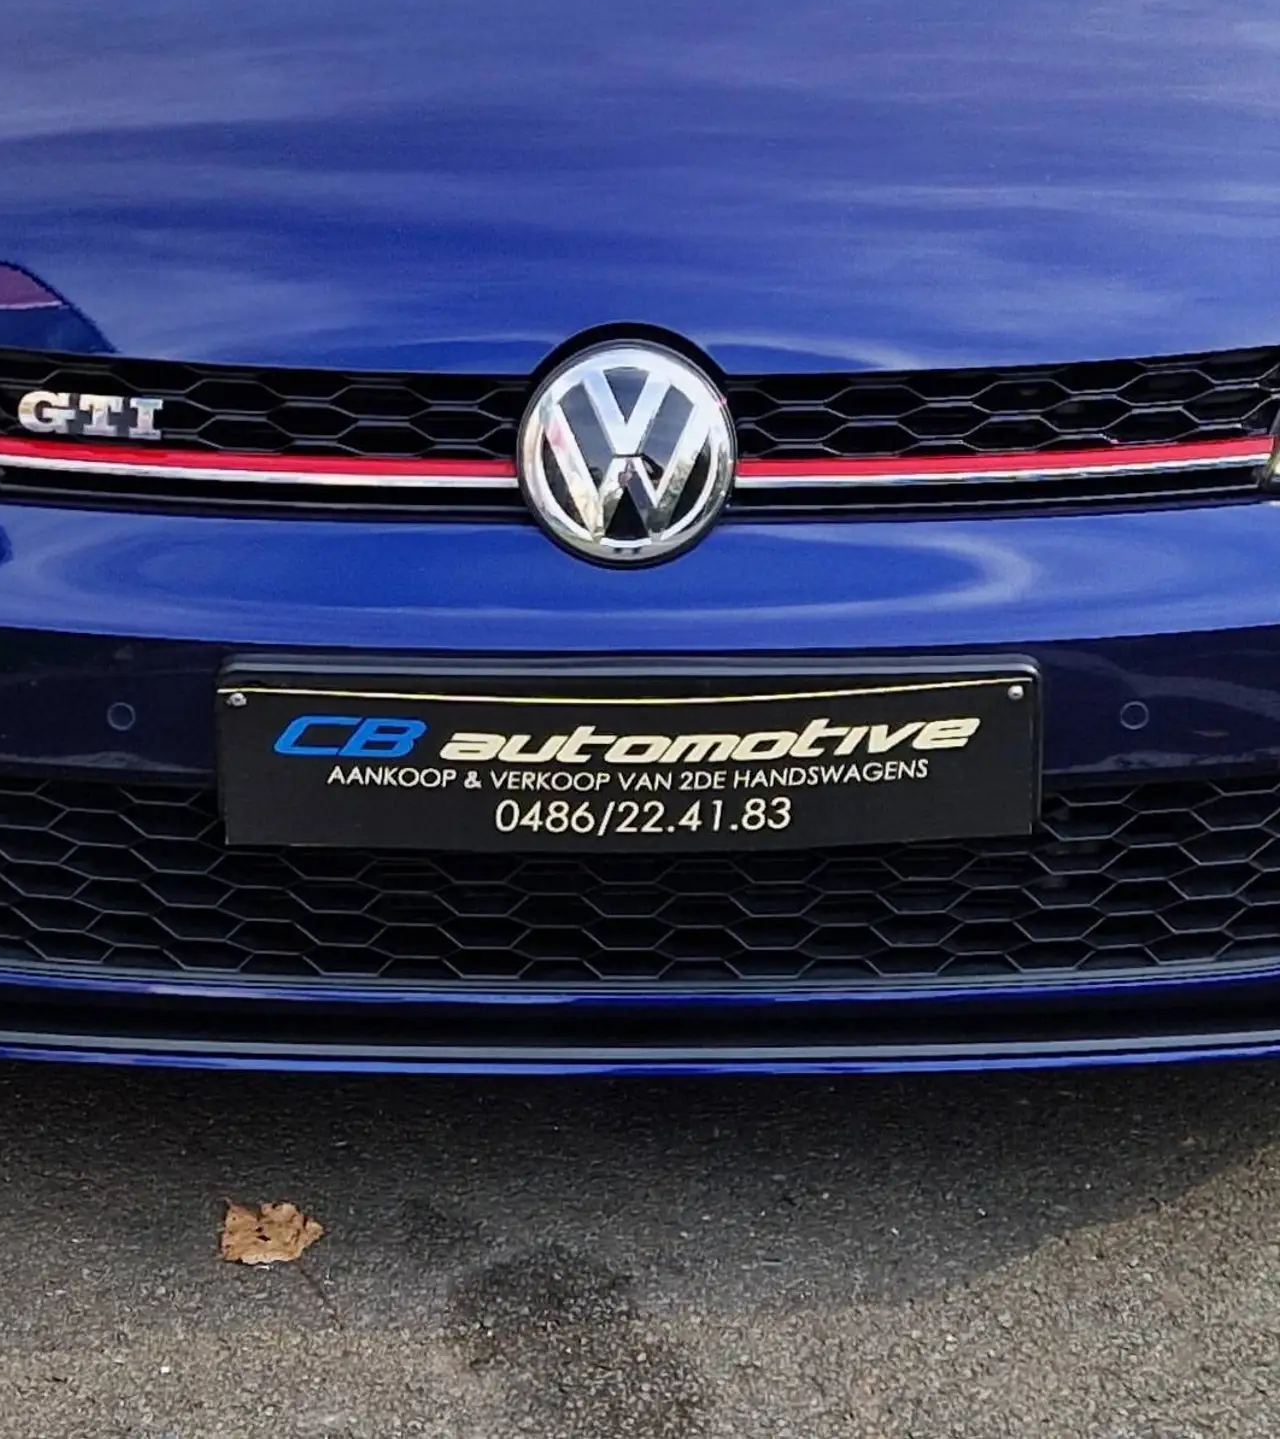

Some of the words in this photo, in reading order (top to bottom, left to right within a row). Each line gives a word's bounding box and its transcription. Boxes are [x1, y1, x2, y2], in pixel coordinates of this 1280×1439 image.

[18, 391, 163, 440] GTI
[526, 350, 727, 552] VW
[273, 715, 428, 757] CB
[439, 717, 980, 763] automotive
[327, 765, 457, 789] AANKOOP
[463, 770, 482, 789] &
[490, 770, 611, 792] VERKOOP
[618, 771, 672, 792] VAN
[679, 770, 727, 792] 2DE
[733, 758, 929, 789] HANDSWAGENS
[495, 796, 792, 837] 0486/22.41.83
